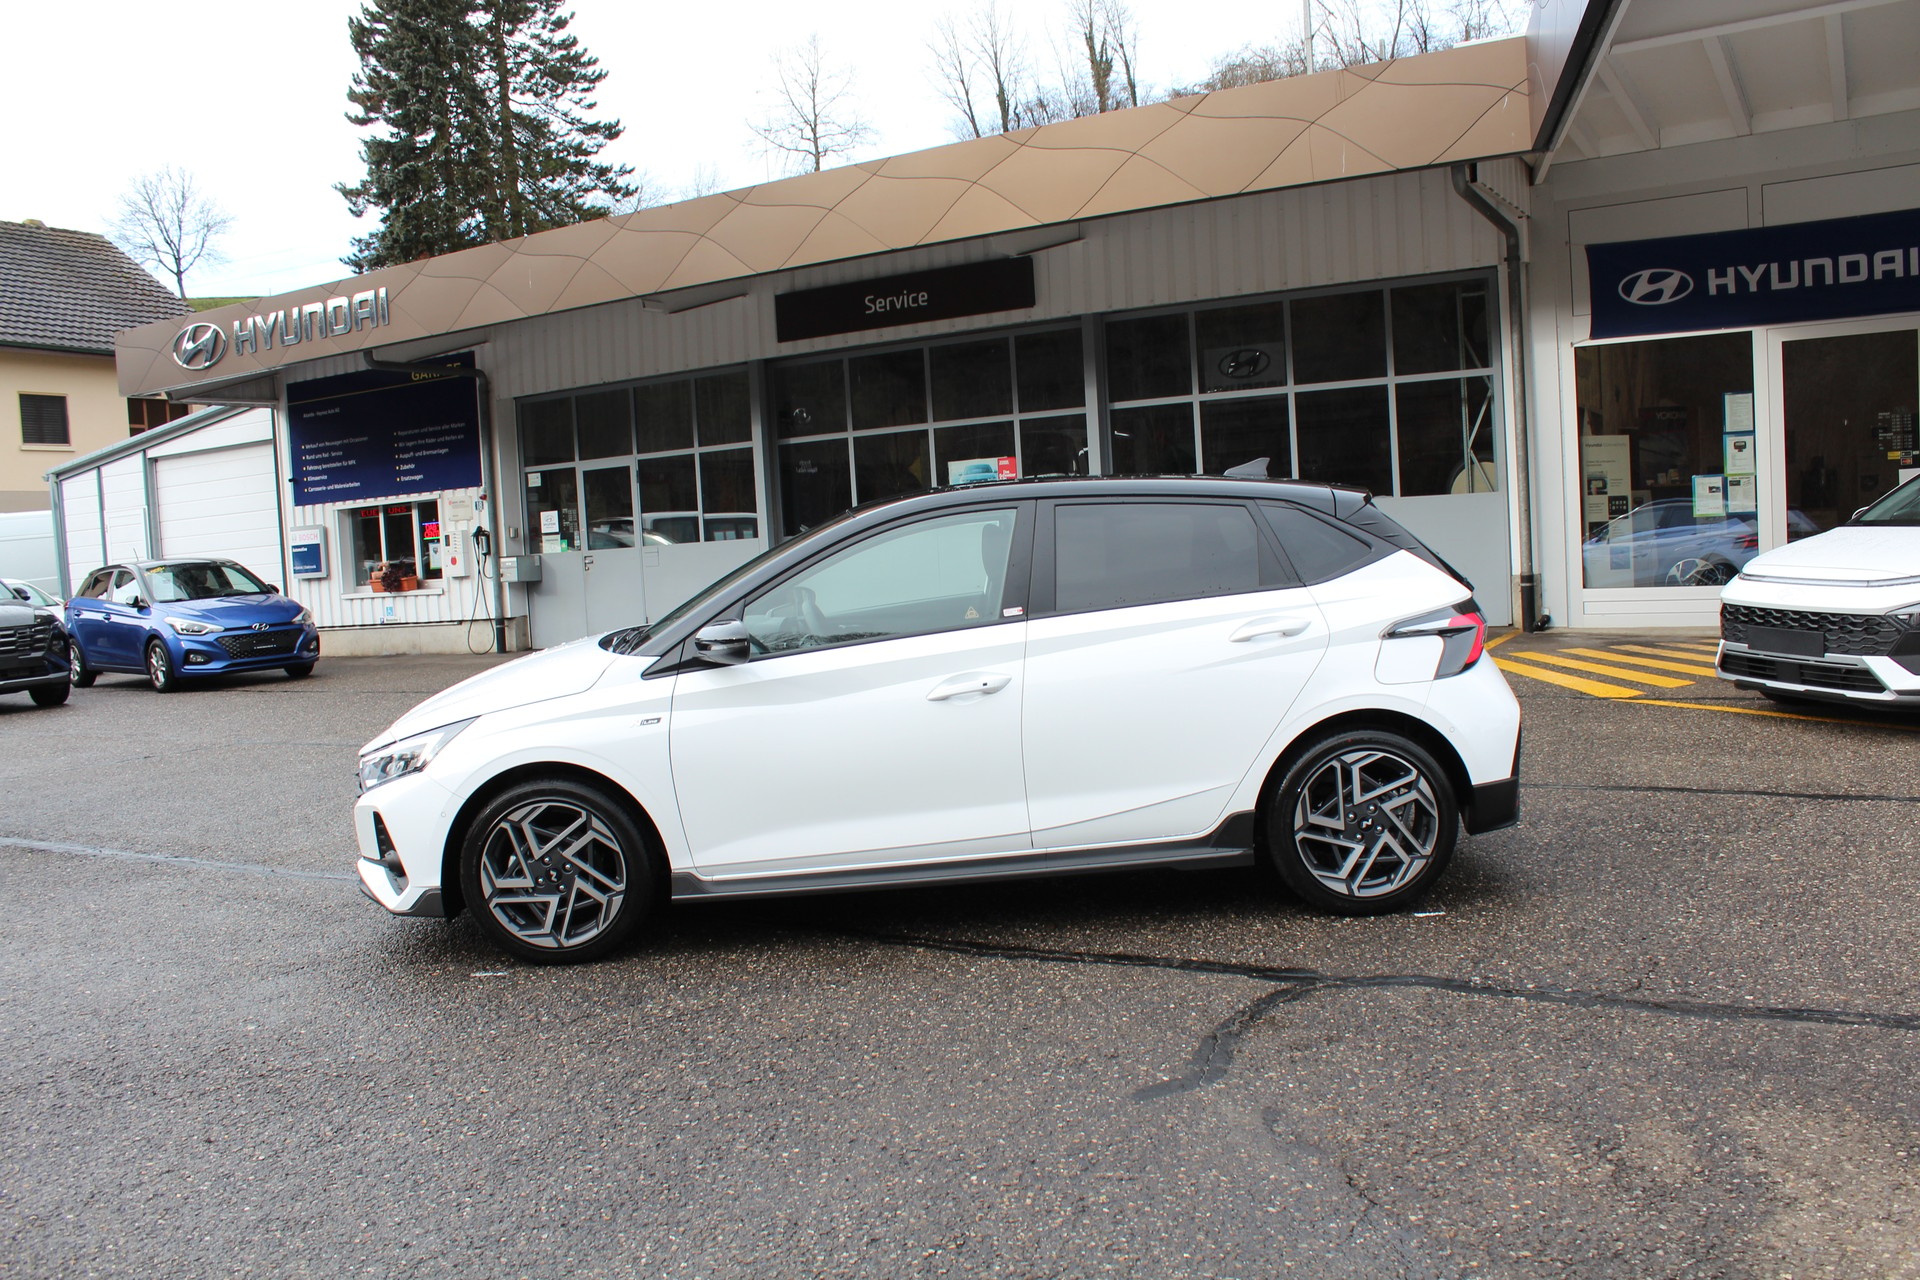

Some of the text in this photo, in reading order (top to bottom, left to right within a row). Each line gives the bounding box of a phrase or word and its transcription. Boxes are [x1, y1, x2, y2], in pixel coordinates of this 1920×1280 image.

[1707, 247, 1919, 296] HYUNDAI
[864, 290, 928, 314] Service
[233, 287, 389, 356] HYUNDAI
[400, 463, 416, 471] Zubehör
